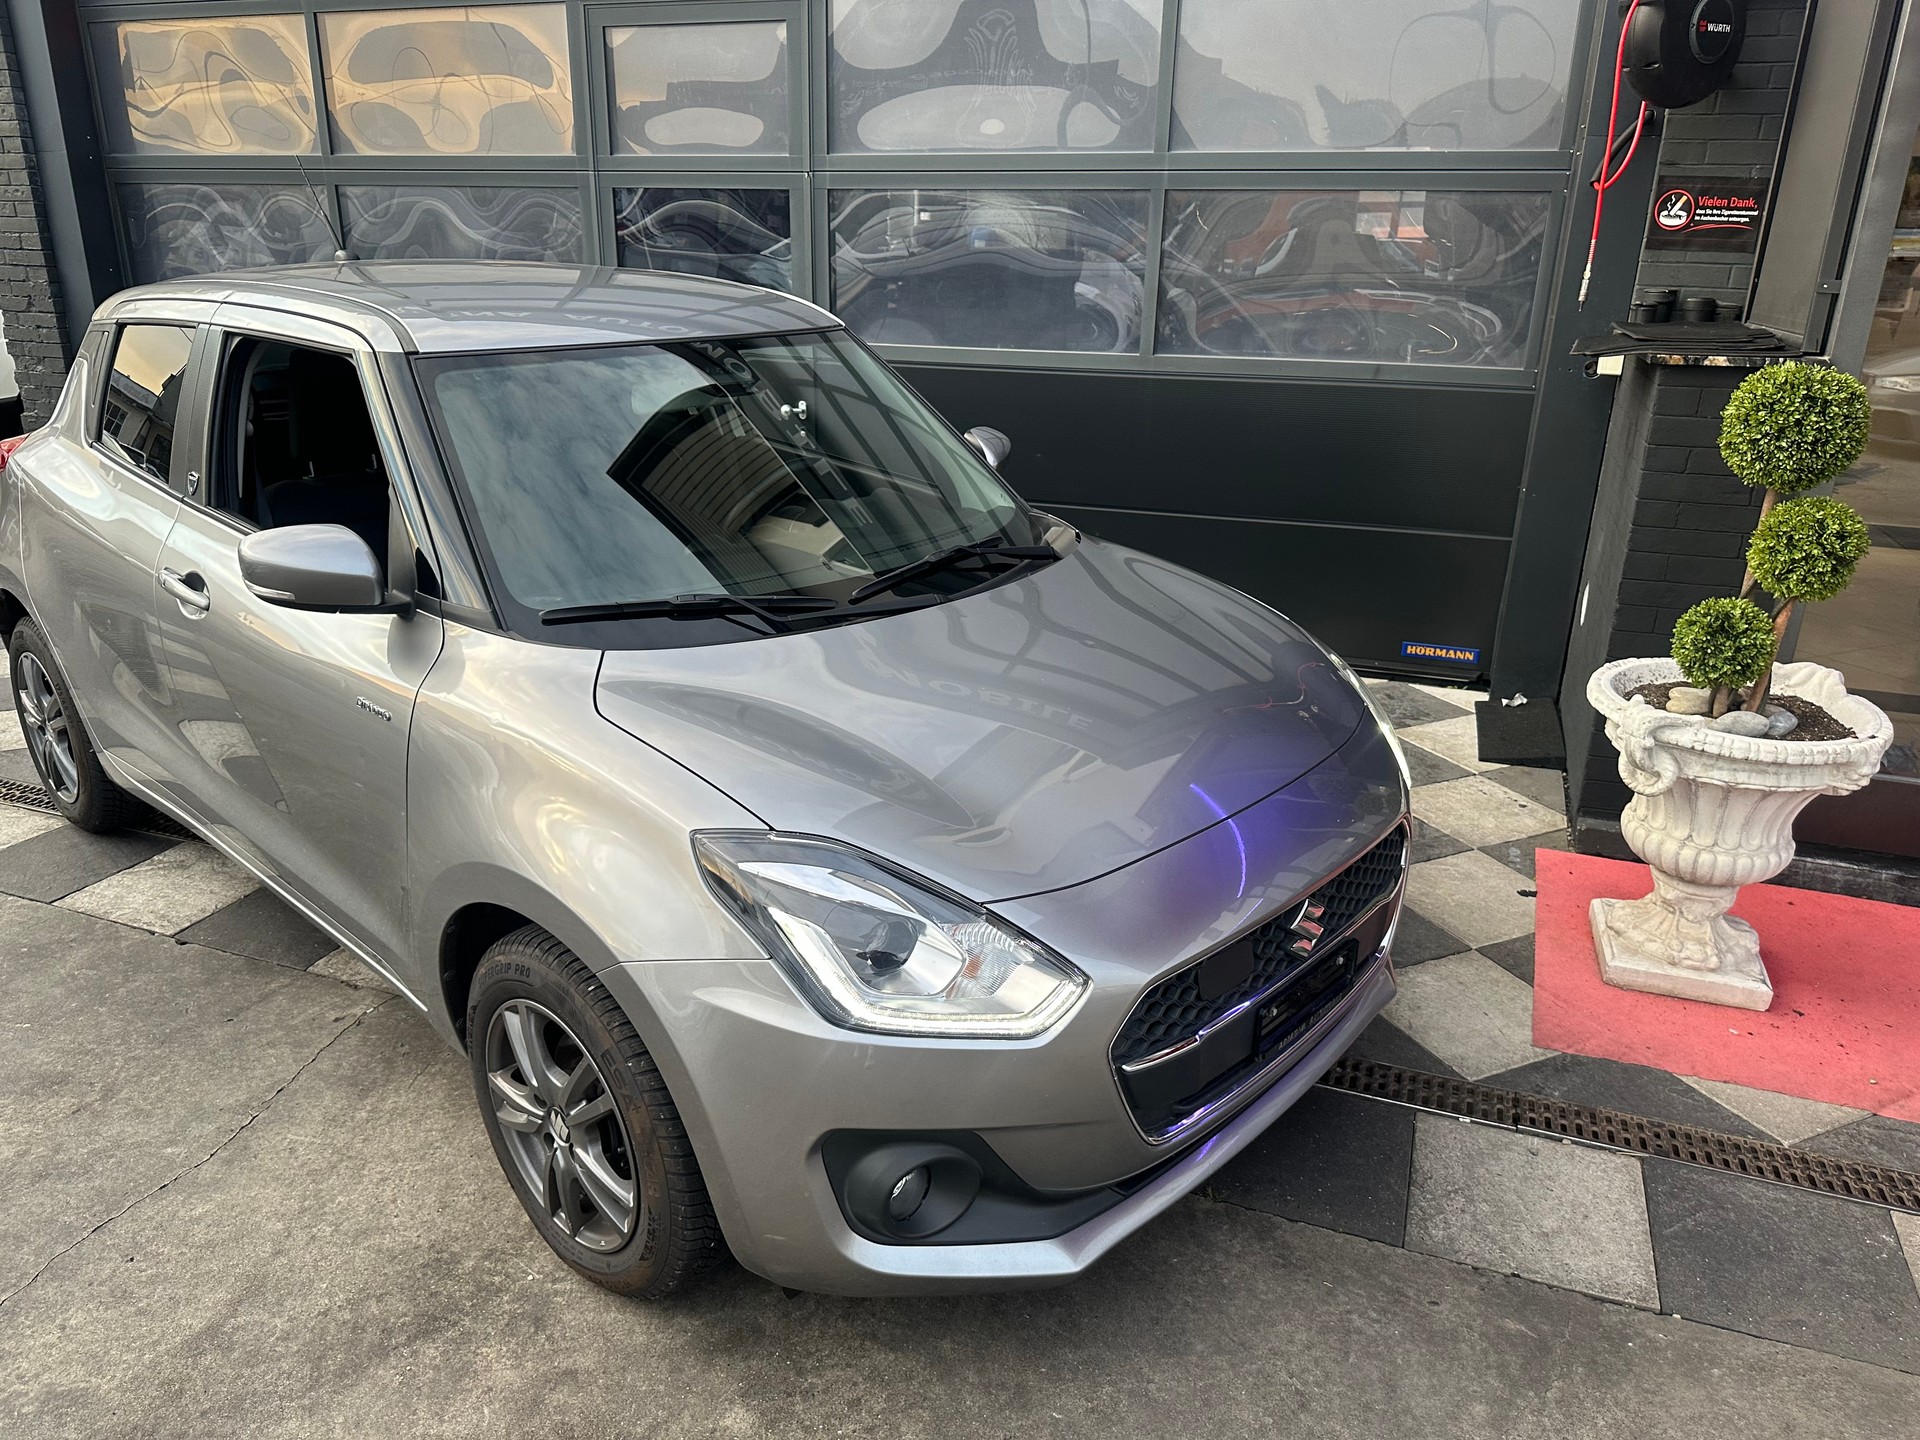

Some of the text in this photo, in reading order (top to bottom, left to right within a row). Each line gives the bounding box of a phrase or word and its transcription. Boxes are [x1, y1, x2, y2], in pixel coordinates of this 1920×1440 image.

[1707, 22, 1731, 33] WÜRTH
[1698, 196, 1758, 209] Vielen Dank,
[1406, 645, 1475, 661] HÖRMANN
[514, 963, 531, 978] PRO
